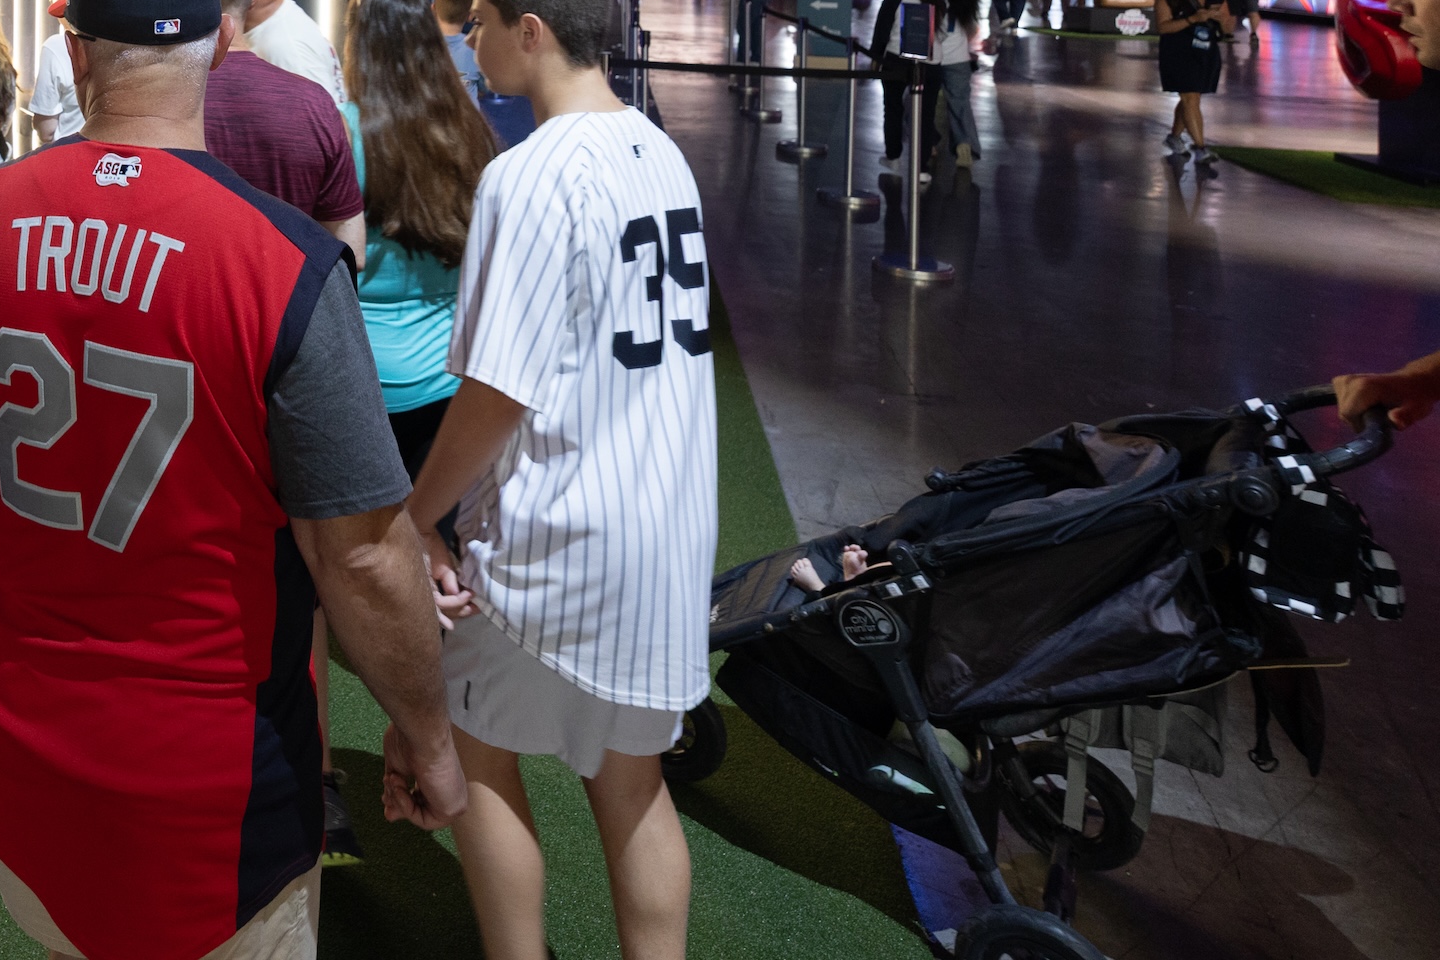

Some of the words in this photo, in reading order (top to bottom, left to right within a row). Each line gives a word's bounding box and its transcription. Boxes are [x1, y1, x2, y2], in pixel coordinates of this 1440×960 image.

[95, 162, 120, 176] ASG
[11, 215, 186, 313] TROUT
[612, 207, 713, 370] 35
